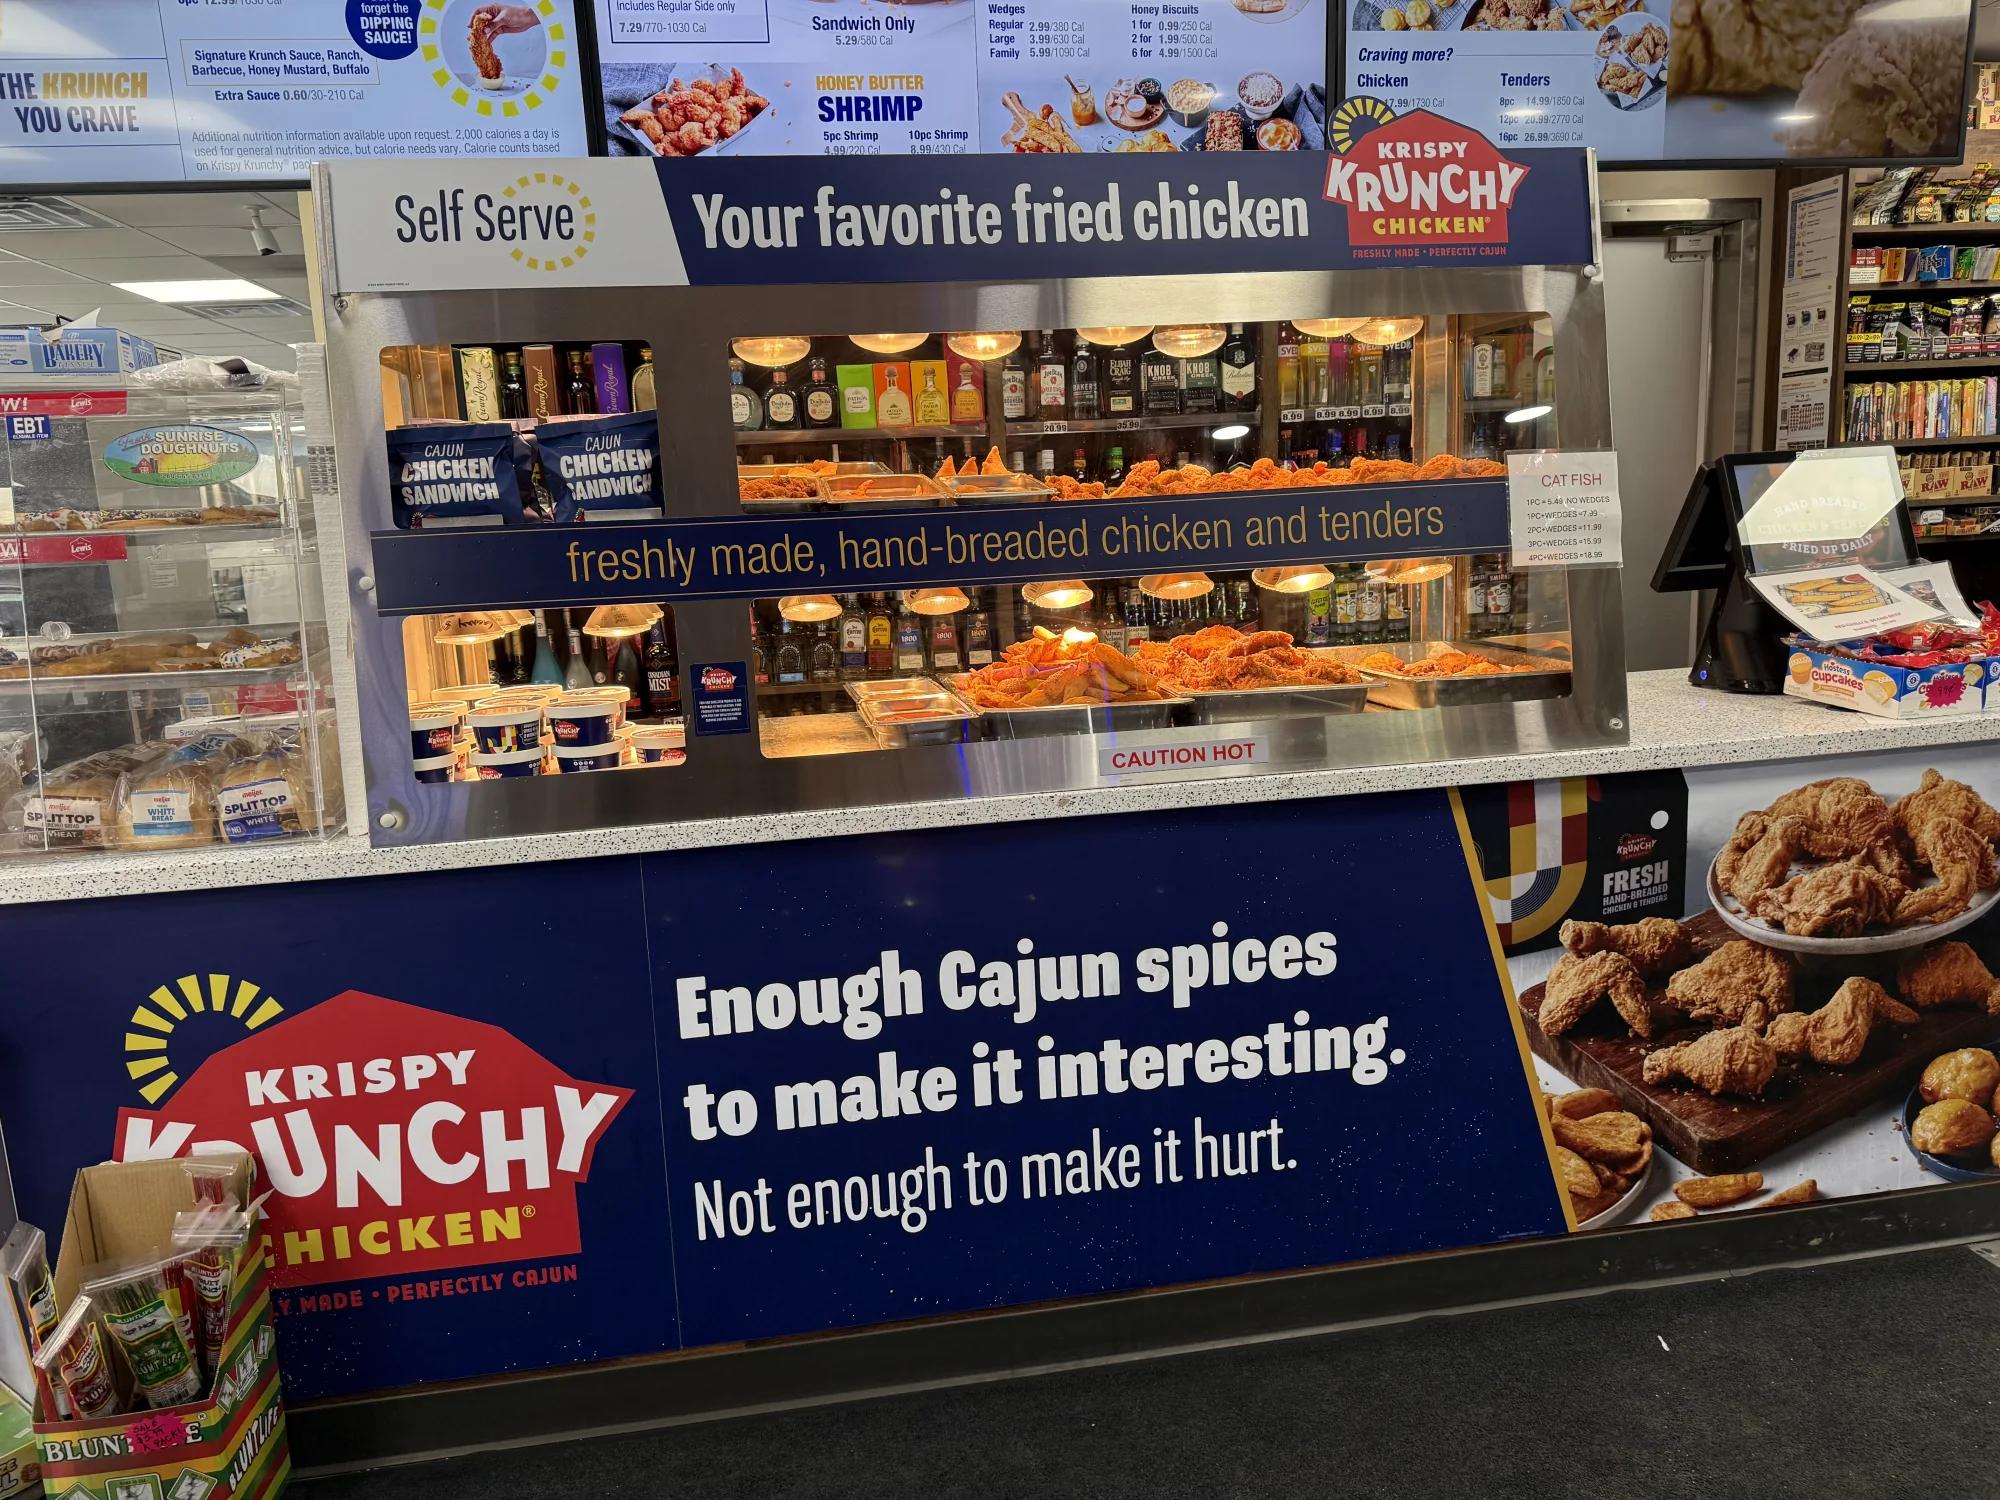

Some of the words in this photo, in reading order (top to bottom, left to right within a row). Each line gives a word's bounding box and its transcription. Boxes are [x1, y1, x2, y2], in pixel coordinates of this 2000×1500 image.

[361, 3, 391, 14] forget
[393, 3, 409, 13] the
[617, 0, 654, 12] Includes
[658, 0, 695, 13] Regular
[696, 0, 715, 12] Side
[716, 1, 736, 14] only
[988, 4, 1026, 16] Wedges
[1131, 4, 1161, 16] Honey
[1162, 4, 1199, 16] Biscuits
[360, 17, 414, 30] DIPPING
[619, 21, 690, 34] 7.29/770-1030
[692, 21, 707, 33] Cal
[812, 16, 882, 32] Sandwich
[885, 16, 916, 34] Only
[989, 19, 1024, 32] Regular
[1029, 20, 1070, 32] 2.99/380
[1072, 20, 1085, 32] Cal
[1131, 20, 1137, 30] 1
[1139, 19, 1152, 30] for
[1158, 20, 1198, 31] 0.99/250
[1199, 20, 1213, 31] Cal
[364, 31, 411, 44] SAUCE!
[835, 34, 877, 46] 5.29/580
[879, 35, 893, 46] Cal
[194, 50, 246, 63] Signature
[249, 50, 287, 61] Krunch
[289, 50, 325, 63] Sauce,
[327, 50, 364, 62] Ranch,
[1358, 48, 1408, 66] Craving
[1411, 48, 1454, 62] more?
[192, 65, 246, 77] Barbecue,
[248, 65, 281, 79] Honey
[283, 64, 331, 77] Mustard,
[333, 64, 370, 76] Buffalo
[0, 73, 38, 100] THE
[42, 72, 148, 99] KRUNCH
[815, 75, 865, 91] HONEY
[868, 75, 925, 91] BUTTER
[1357, 73, 1409, 88] Chicken
[1501, 72, 1550, 88] Tenders
[214, 90, 244, 101] Extra
[246, 90, 280, 101] Sauce
[283, 90, 346, 102] 0.60/30-210
[349, 90, 364, 101] Cal
[1499, 98, 1515, 109] 8pc
[1573, 96, 1585, 106] Cal
[818, 96, 923, 123] SHRIMP
[14, 106, 62, 134] YOU
[66, 106, 140, 133] CRAVE
[192, 130, 240, 142] Additional
[243, 130, 283, 142] nutrition
[286, 130, 341, 142] information
[344, 130, 385, 141] available
[388, 132, 410, 143] upon
[414, 130, 453, 142] request.
[455, 129, 483, 142] 2,000
[485, 128, 522, 140] calories
[532, 128, 549, 142] day
[551, 128, 560, 139] is
[823, 130, 843, 142] 5pc
[844, 130, 879, 143] Shrimp
[908, 130, 933, 142] 10pc
[934, 128, 969, 142] Shrimp
[1377, 141, 1468, 159] KRISPY
[1326, 157, 1527, 212] KRUNCHY
[395, 188, 464, 244] Self
[474, 192, 575, 242] Serve
[692, 192, 804, 249] Your
[813, 184, 1003, 249] favorite
[1011, 181, 1124, 244] fried
[1132, 180, 1310, 240] chicken
[1353, 248, 1393, 258] FRESHLY
[1395, 248, 1420, 258] MADE
[1429, 247, 1477, 256] PERFECTLY
[1479, 246, 1506, 256] CAJUN
[42, 343, 104, 368] BAKERY
[1148, 364, 1172, 376] KNOB
[1316, 411, 1336, 419] 8.99
[13, 416, 44, 434] EBT
[1044, 424, 1067, 432] 20.99
[155, 431, 224, 442] SUNRISE
[585, 433, 622, 452] CAJUN
[141, 443, 240, 454] DOUGHNUTS
[424, 443, 464, 458] CAJUN
[401, 456, 495, 483] CHICKEN
[560, 449, 653, 479] CHICKEN
[1542, 474, 1568, 488] CAT
[1571, 473, 1602, 486] FISH
[1921, 478, 1950, 493] RAW
[1960, 476, 1989, 491] RAW
[401, 481, 500, 506] SANDWICH
[1579, 496, 1610, 504] WEDGES
[567, 538, 696, 588] freshly
[711, 533, 826, 578] made,
[838, 518, 1088, 570] hand-breaded
[1101, 513, 1233, 556] chicken
[1245, 505, 1307, 546] and
[1318, 500, 1444, 542] tenders
[1782, 540, 1818, 555] FRIED
[1821, 544, 1838, 554] UP
[1844, 533, 1874, 551] DAILY
[1824, 664, 1850, 676] Hostess
[649, 678, 670, 691] MIST
[1811, 670, 1864, 692] Cupcakes
[1112, 748, 1203, 770] CAUTION
[1213, 743, 1256, 762] HOT
[147, 808, 176, 816] WHITE
[224, 802, 260, 815] SPLIT
[260, 794, 287, 807] TOP
[246, 816, 274, 826] WHITE
[1603, 860, 1668, 897] FRESH
[1602, 883, 1668, 907] HAND-BREADED
[1602, 901, 1633, 916] CHICKEN
[1639, 894, 1668, 909] TENDERS
[676, 950, 924, 1040] Enough
[939, 938, 1120, 1024] Cajun
[1136, 921, 1338, 1009] spices
[245, 1049, 476, 1107] KRISPY
[683, 1083, 758, 1141] to
[774, 1051, 958, 1131] make
[972, 1041, 1024, 1107] it
[1038, 1010, 1407, 1100] interesting.
[694, 1178, 777, 1241] Not
[787, 1146, 952, 1233] enough
[963, 1152, 1008, 1206] to
[1021, 1127, 1140, 1200] make
[1154, 1127, 1184, 1184] it
[1194, 1116, 1298, 1180] hurt.
[300, 1290, 364, 1315] MADE
[387, 1272, 504, 1304] PERFECTLY
[512, 1264, 578, 1290] CAJUN
